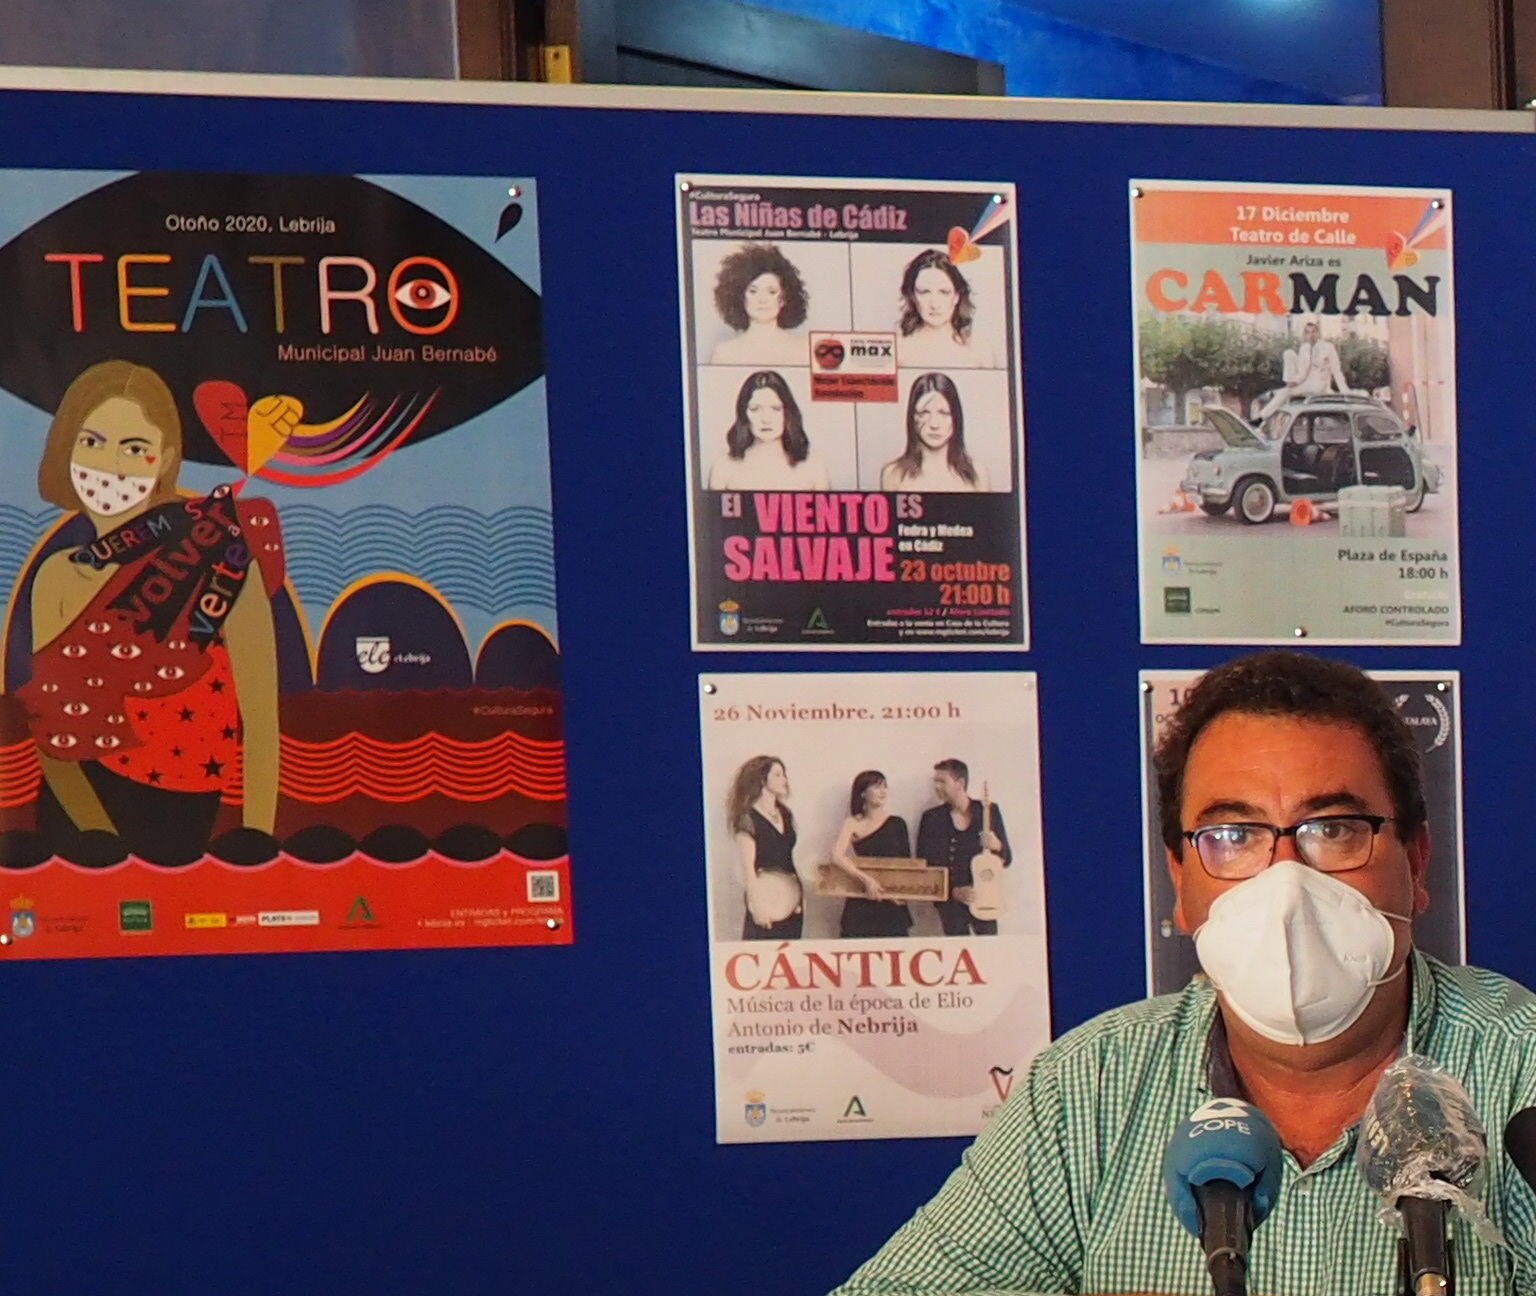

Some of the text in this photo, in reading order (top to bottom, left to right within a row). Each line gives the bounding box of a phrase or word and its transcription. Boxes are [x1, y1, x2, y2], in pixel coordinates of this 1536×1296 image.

[166, 214, 220, 232] Otoño
[279, 215, 335, 234] Lebrija
[690, 201, 908, 231] Las Niñas de Cádiz
[1236, 206, 1349, 224] 17 Diciembre
[1230, 227, 1356, 245] Teatro de Calle
[1246, 254, 1341, 267] Javier Ariza es
[44, 253, 458, 335] TEATRO
[1145, 268, 1441, 317] CARMAN
[278, 344, 497, 364] Municipal Juan Bernabé
[851, 345, 892, 357] max
[754, 494, 889, 533] VIENTO
[897, 494, 923, 518] ES
[724, 536, 896, 582] SALVAJE
[1338, 549, 1448, 564] Plaza de España
[901, 560, 1010, 581] 23 octubre
[1399, 567, 1448, 579] 18:00 h
[940, 584, 1010, 605] 21:00 h
[1380, 605, 1449, 615] CONTROLADO
[714, 702, 961, 721] 26 Noviembre. 21:00 h
[725, 943, 987, 991] CÁNTICA
[727, 992, 973, 1015] Música de la época de Elio
[728, 1017, 919, 1038] Antonio de Nebrija
[728, 1042, 794, 1055] entradas:
[1189, 1118, 1251, 1138] COPE
